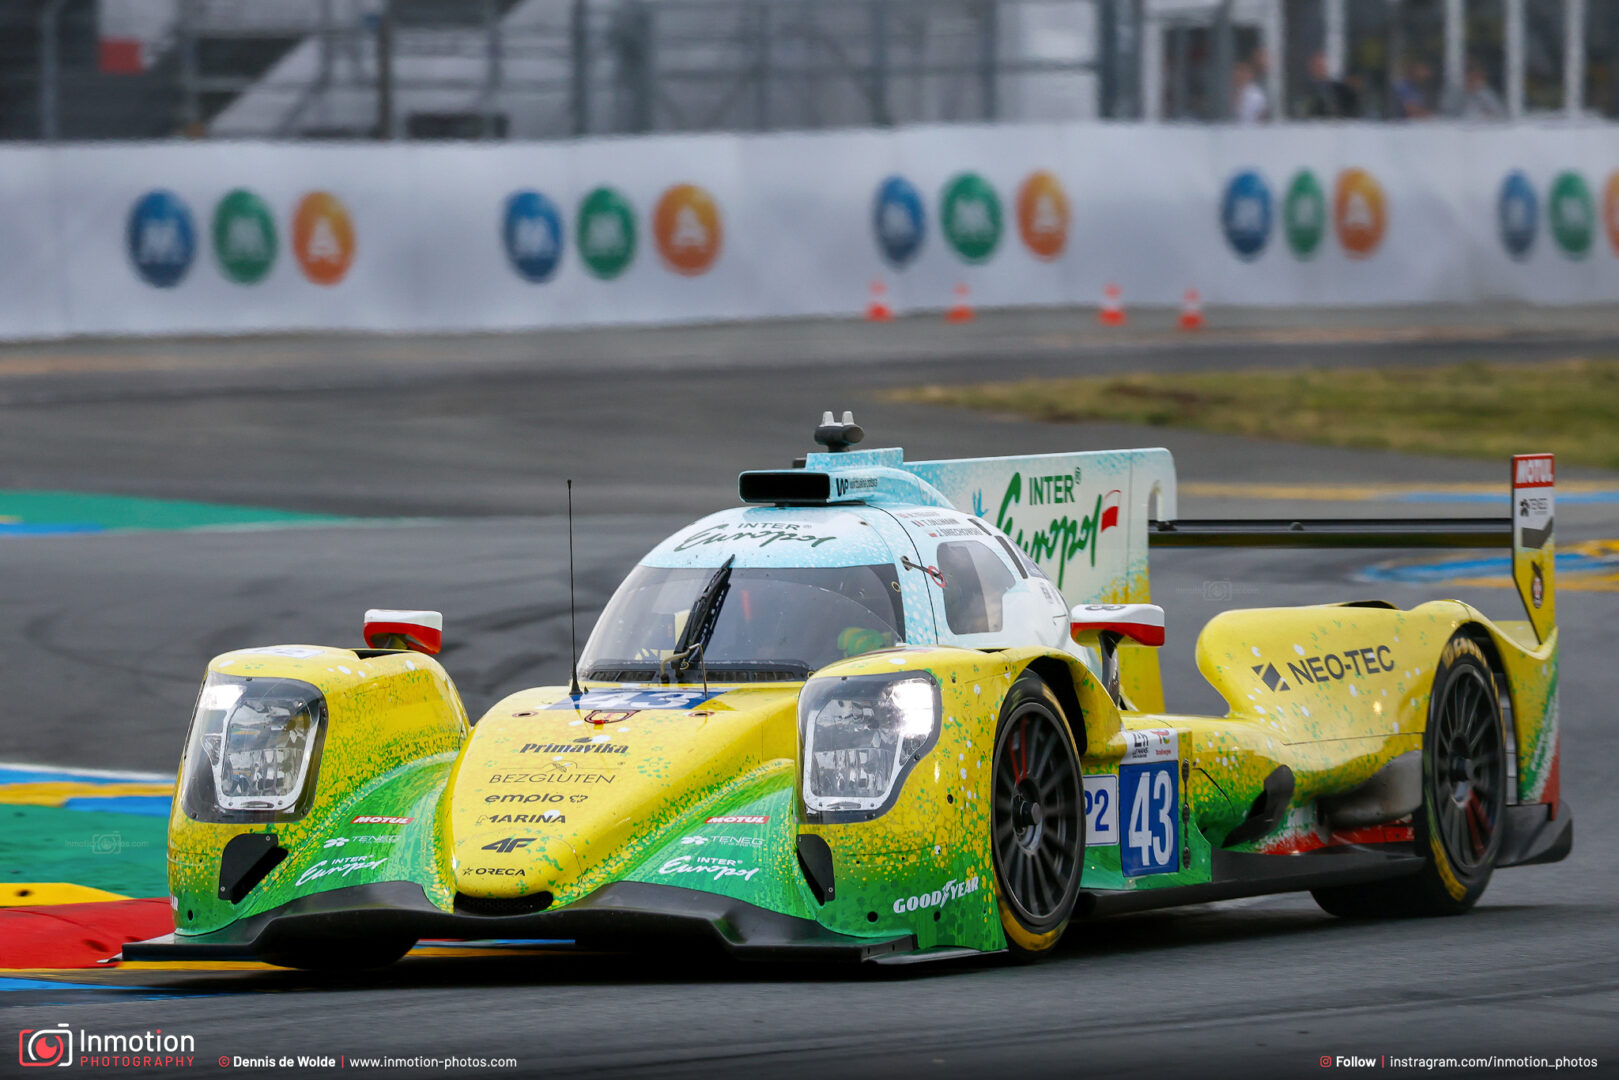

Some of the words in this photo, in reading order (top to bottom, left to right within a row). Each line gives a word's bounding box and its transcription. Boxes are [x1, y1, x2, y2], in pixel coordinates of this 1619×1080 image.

[1516, 459, 1553, 484] MOTUL
[1028, 475, 1075, 506] INTER
[737, 522, 801, 532] INTER
[673, 523, 837, 553] Europol
[1286, 645, 1395, 686] NEO-TEC
[519, 741, 629, 754] Primavika
[488, 774, 616, 785] BEZGLUTEN
[484, 793, 564, 804] emplo
[353, 816, 409, 824] MOTUL
[476, 813, 567, 824] MARINA
[707, 816, 765, 824] MOTUL
[1128, 769, 1174, 867] 43
[331, 855, 368, 865] INTER
[696, 856, 737, 867] INTER
[475, 867, 526, 877] ORECA
[892, 875, 979, 914] GOODYEAR
